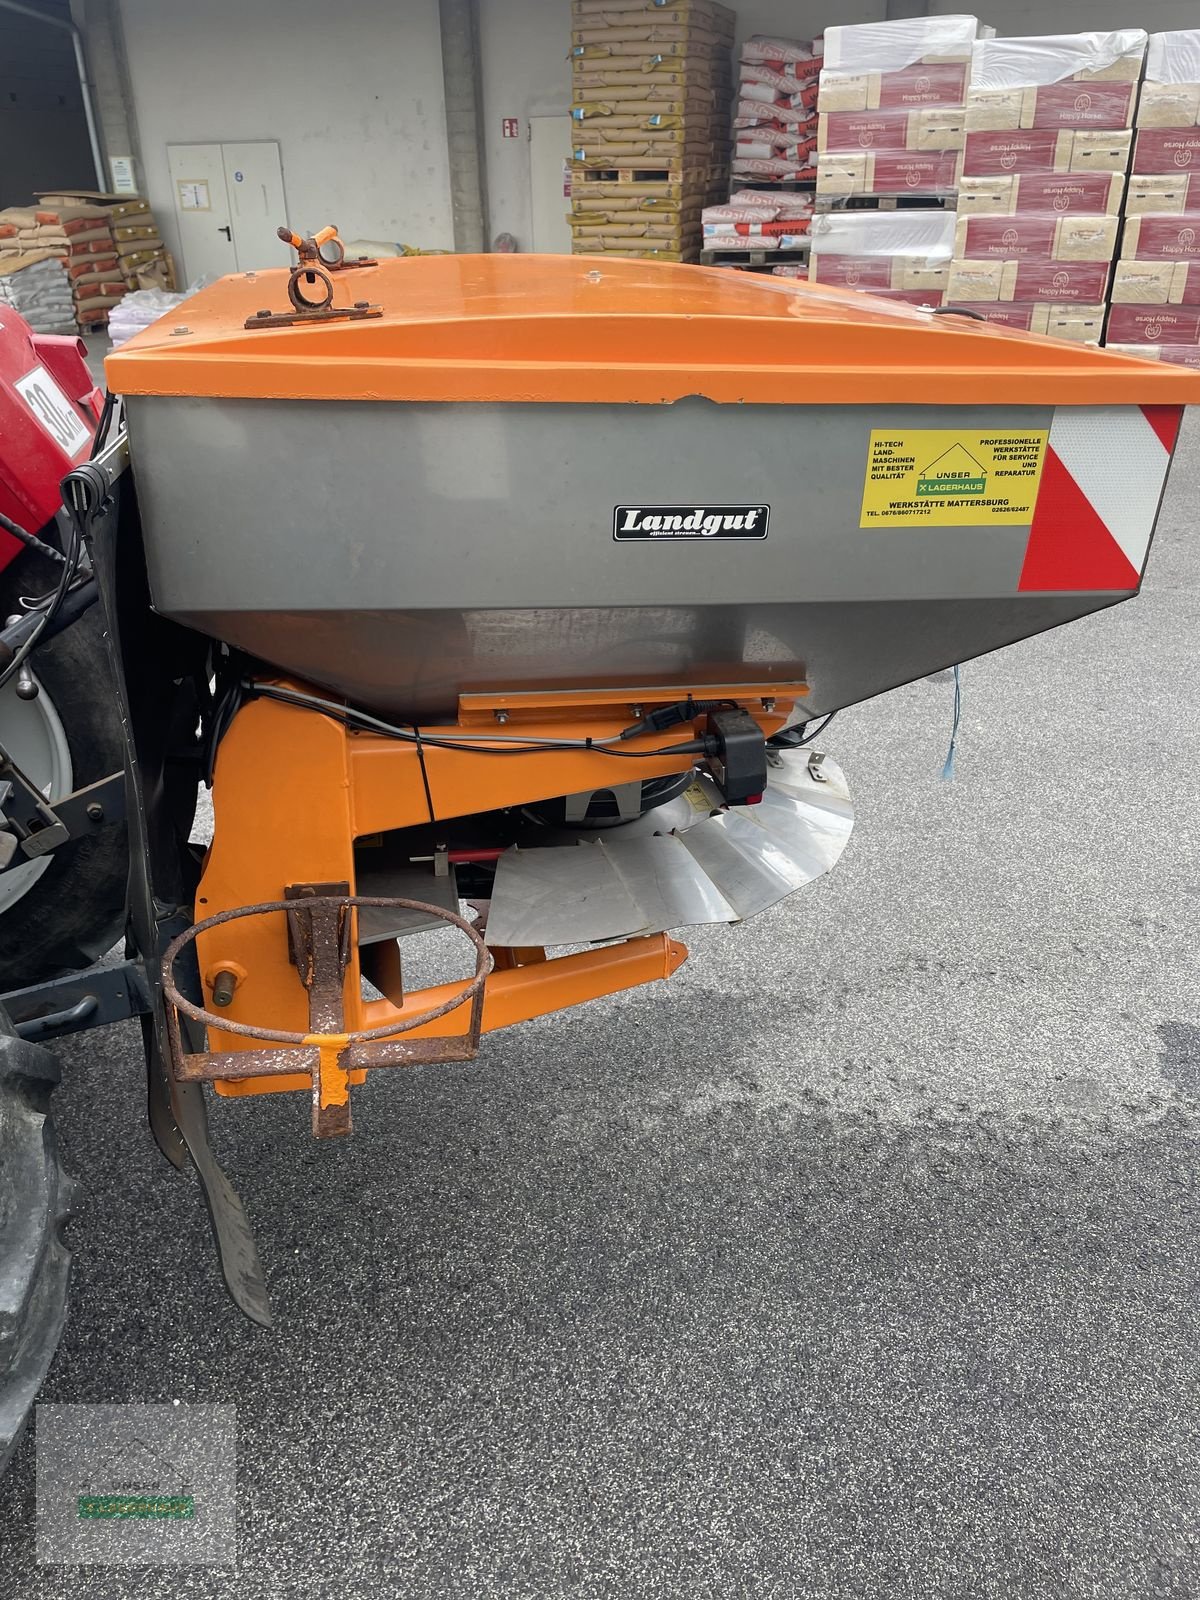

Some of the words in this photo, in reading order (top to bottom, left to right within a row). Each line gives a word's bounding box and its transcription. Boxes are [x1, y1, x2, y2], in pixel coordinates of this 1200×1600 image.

[1059, 113, 1081, 121] Happy
[1009, 143, 1031, 151] Happy
[1063, 187, 1085, 195] Happy
[988, 246, 1008, 254] Happy
[1162, 245, 1183, 253] Happy
[1038, 288, 1059, 297] Happy
[987, 313, 1009, 321] Happy
[1155, 315, 1178, 323] Happy
[979, 438, 1041, 446] PROFESSIONELLE
[928, 483, 984, 492] LAGERHAUS
[889, 500, 946, 509] WERKSTÄTTE
[947, 499, 1009, 507] MATTERSBURG
